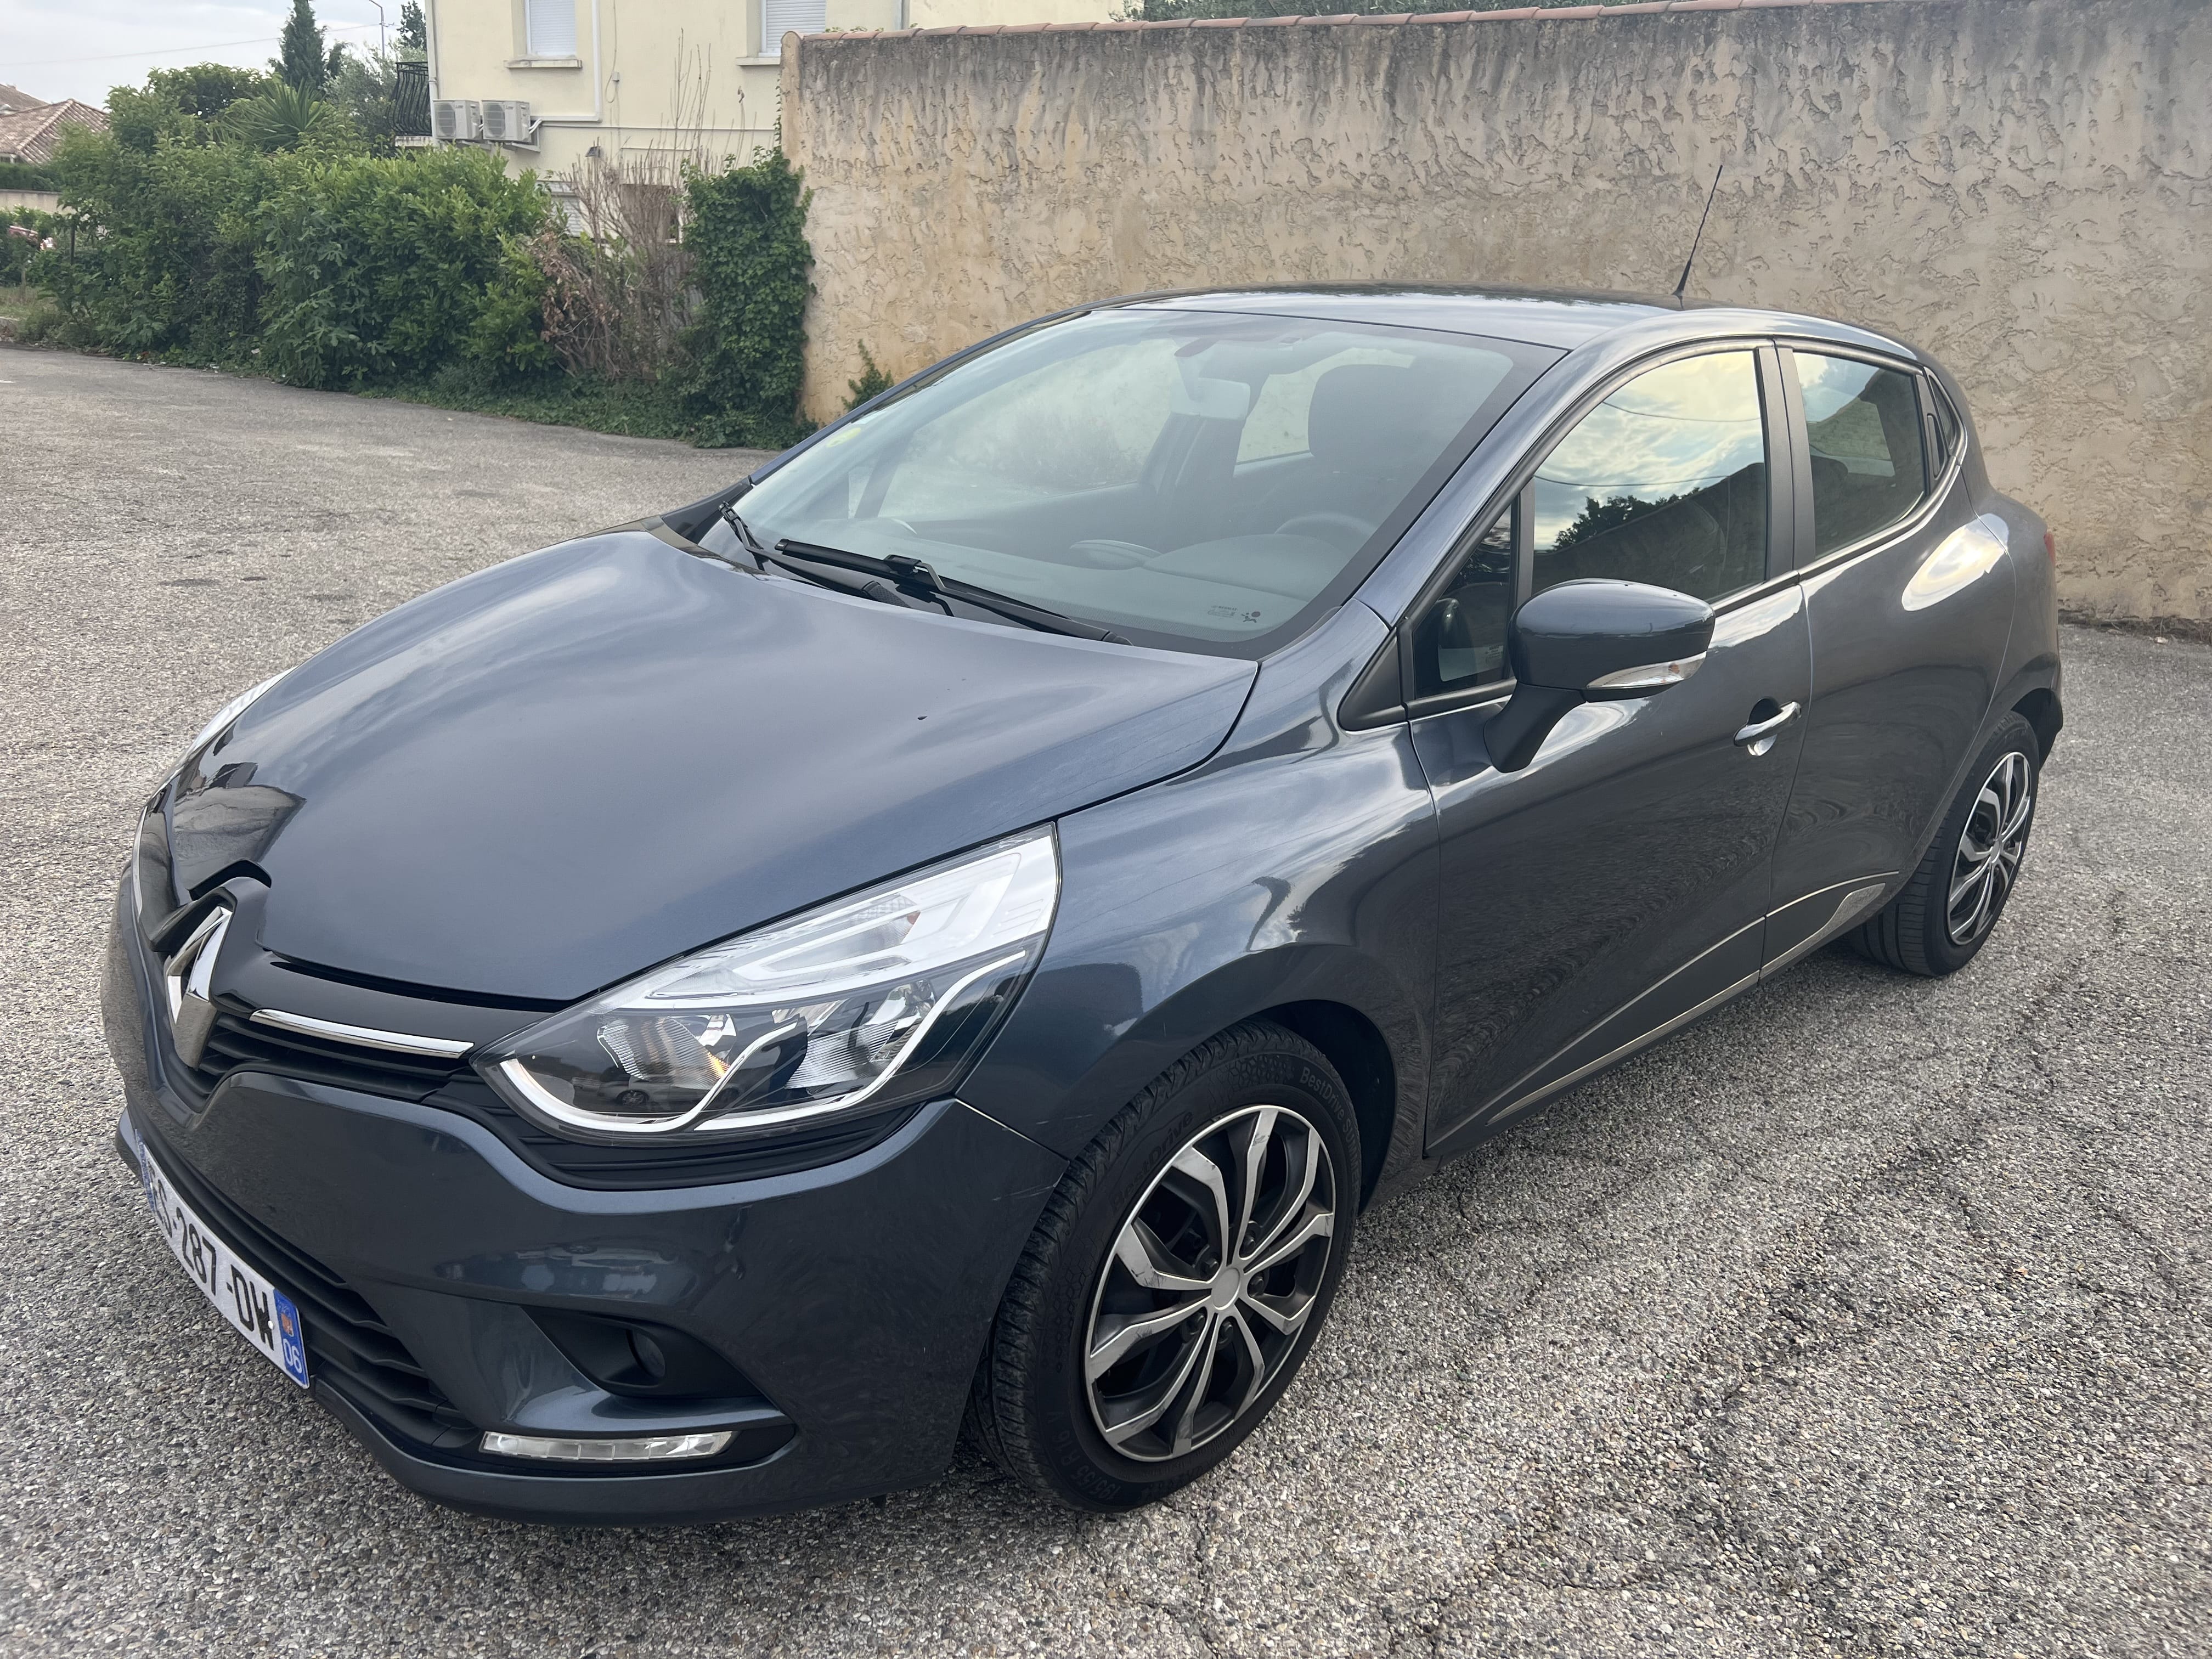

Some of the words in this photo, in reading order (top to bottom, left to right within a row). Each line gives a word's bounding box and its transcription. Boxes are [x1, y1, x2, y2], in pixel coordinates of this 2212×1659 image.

[1299, 1066, 1345, 1121] BestDrive
[1343, 1118, 1361, 1194] SUMMER
[1106, 1111, 1194, 1211] BestDrive
[283, 1338, 302, 1374] 06
[1060, 1449, 1080, 1466] R
[1070, 1464, 1121, 1500] 195/55
